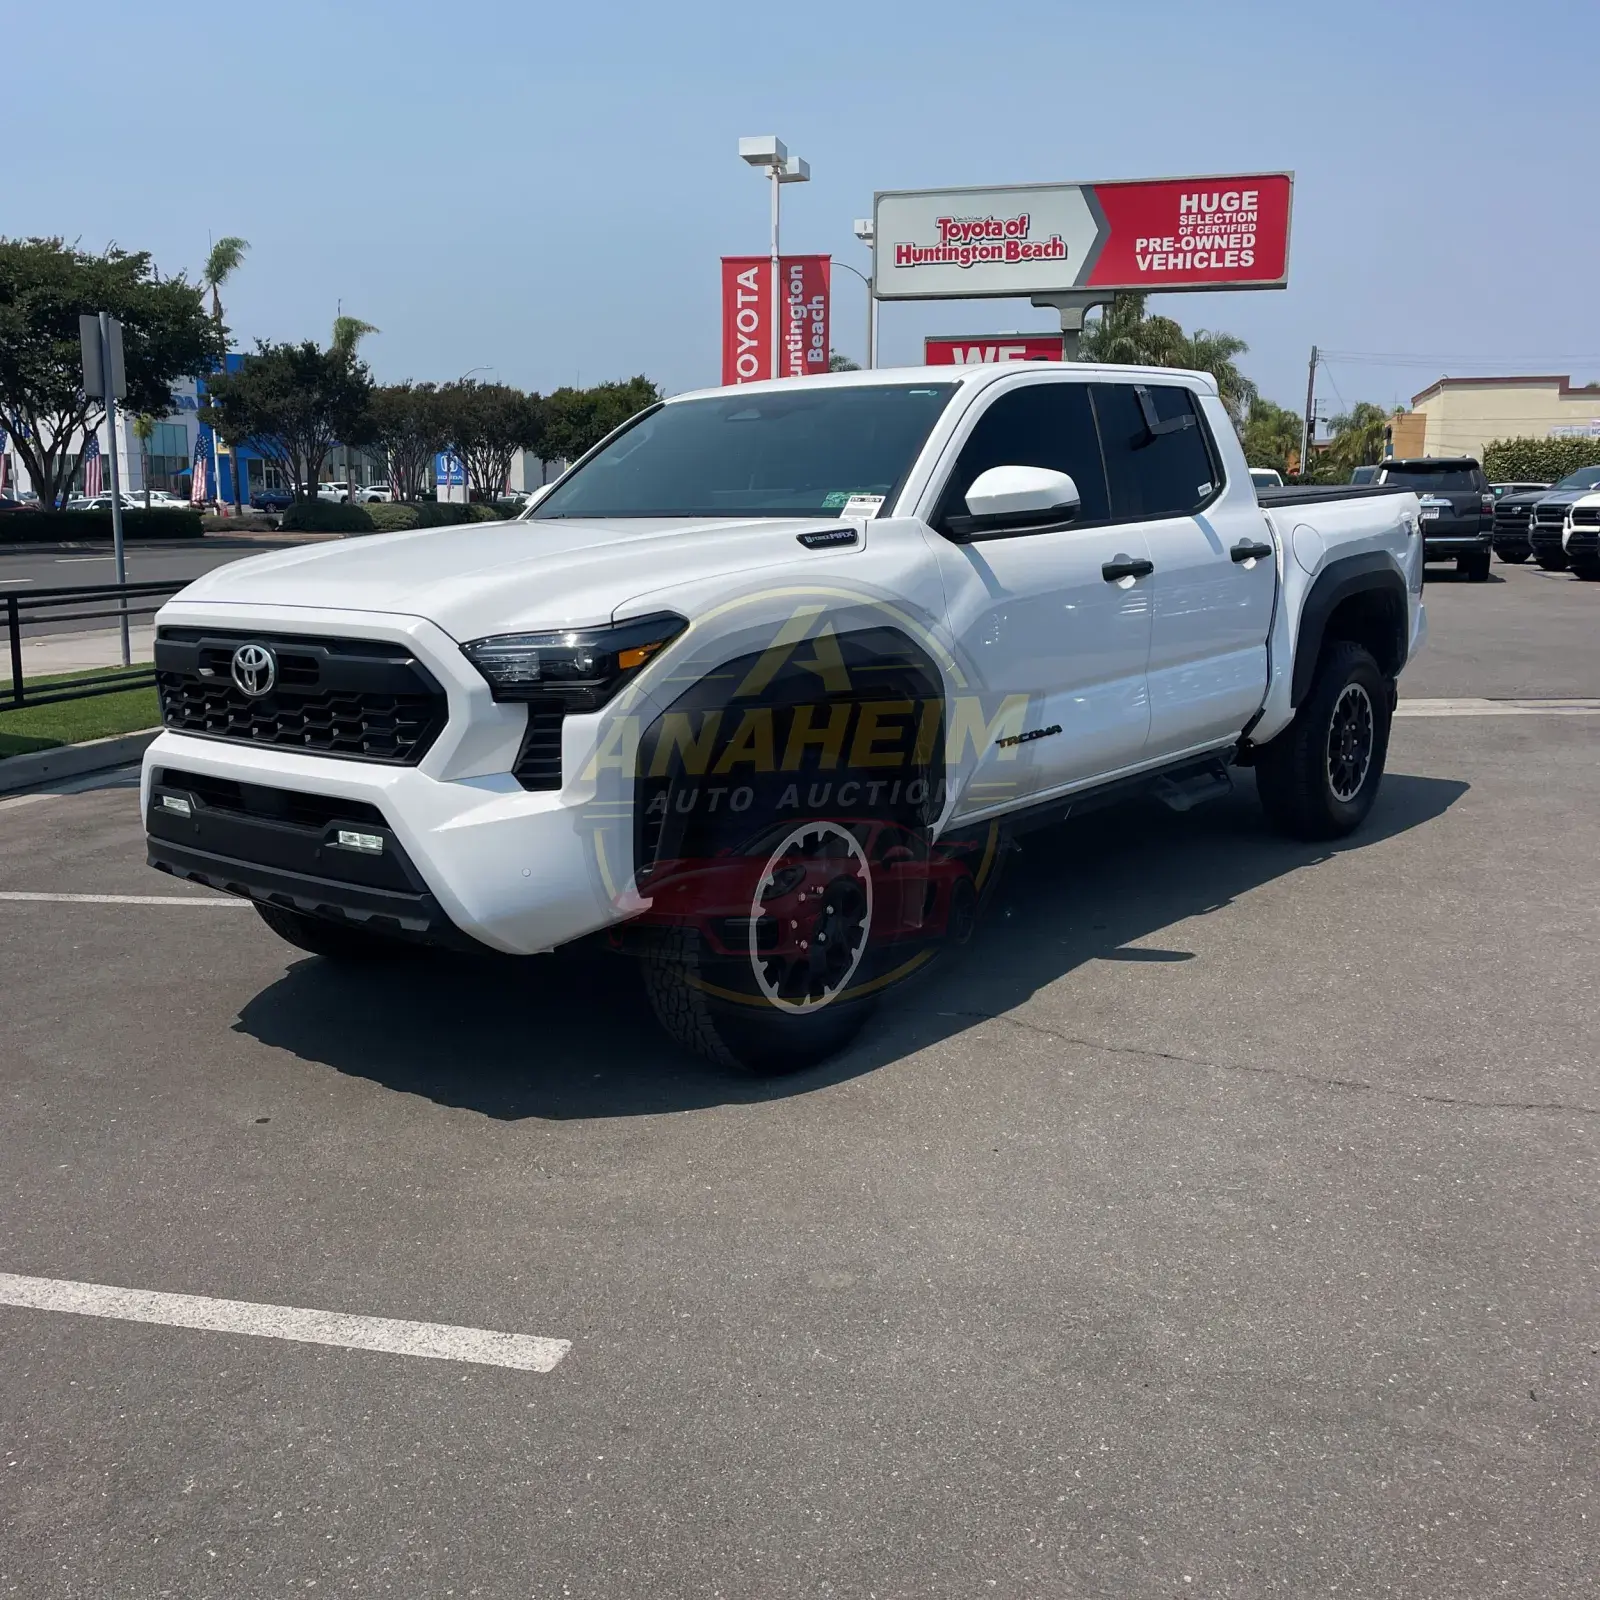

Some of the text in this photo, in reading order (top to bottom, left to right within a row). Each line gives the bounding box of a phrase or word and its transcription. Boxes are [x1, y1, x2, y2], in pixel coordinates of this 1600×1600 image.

[1179, 190, 1259, 214] HUGE
[937, 214, 1027, 242] Toyota of
[1178, 211, 1258, 226] SELECTION
[1178, 223, 1257, 236] OF CERTIFIED
[896, 236, 1065, 266] Huntington Beach
[1135, 233, 1256, 253] PRE-OWNED
[1135, 249, 1255, 272] VEHICLES
[785, 265, 807, 377] untington
[806, 295, 825, 362] Beach
